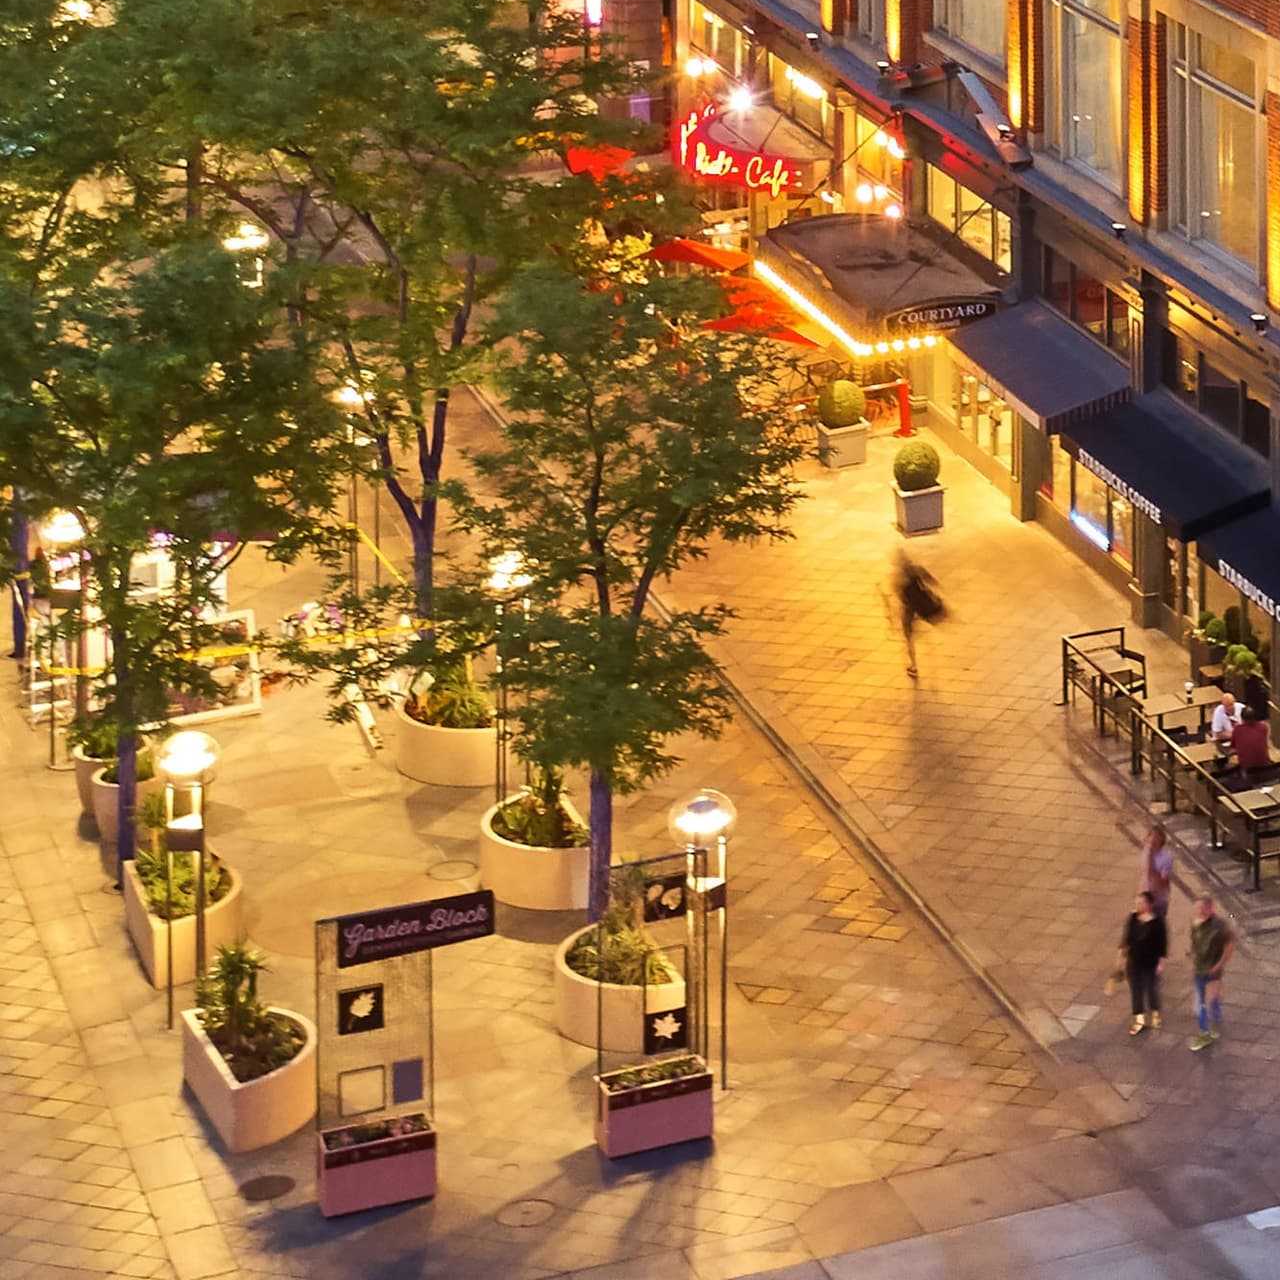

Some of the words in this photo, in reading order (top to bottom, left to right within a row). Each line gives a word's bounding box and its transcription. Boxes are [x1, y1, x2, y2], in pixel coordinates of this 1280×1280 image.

[897, 303, 986, 325] COURTYARD
[1078, 447, 1128, 498] STARBUCKS
[1128, 487, 1161, 525] COFFEE
[1218, 559, 1275, 617] STARBUCKS
[343, 919, 421, 959] Garden
[425, 904, 489, 931] Block
